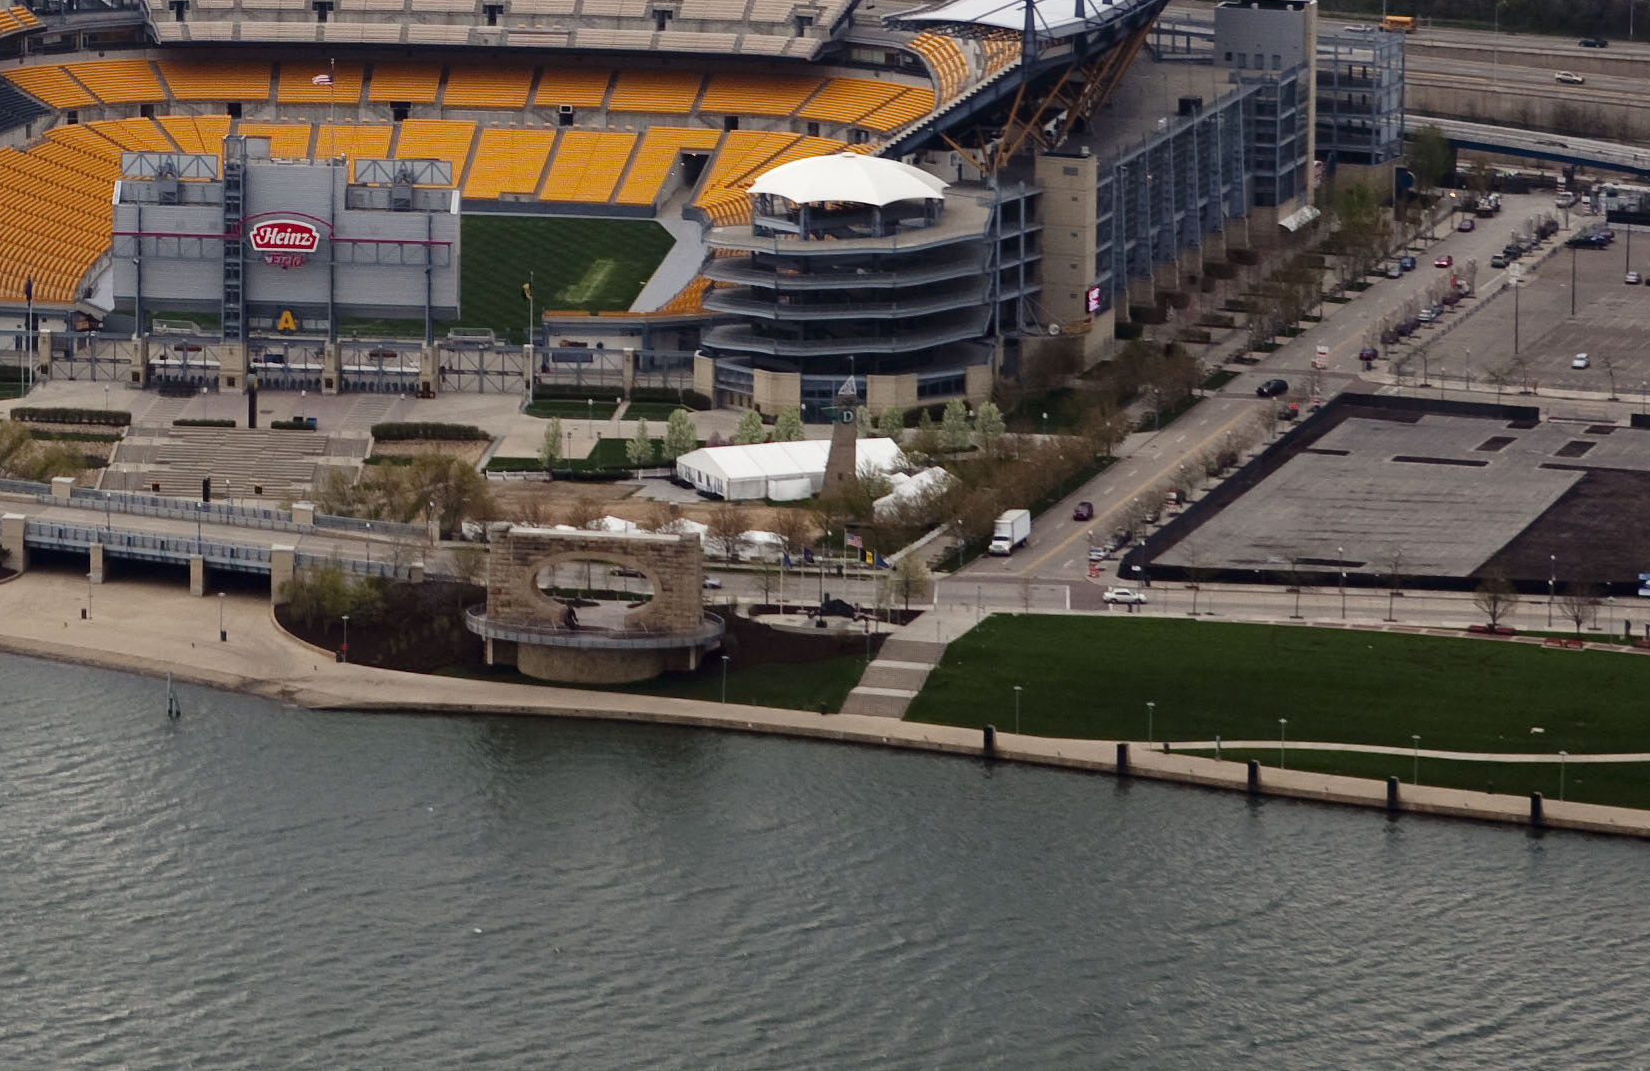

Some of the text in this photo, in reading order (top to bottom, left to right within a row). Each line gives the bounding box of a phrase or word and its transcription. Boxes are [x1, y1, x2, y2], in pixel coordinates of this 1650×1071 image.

[256, 227, 313, 246] Heinz
[278, 309, 296, 332] A
[843, 410, 854, 423] D
